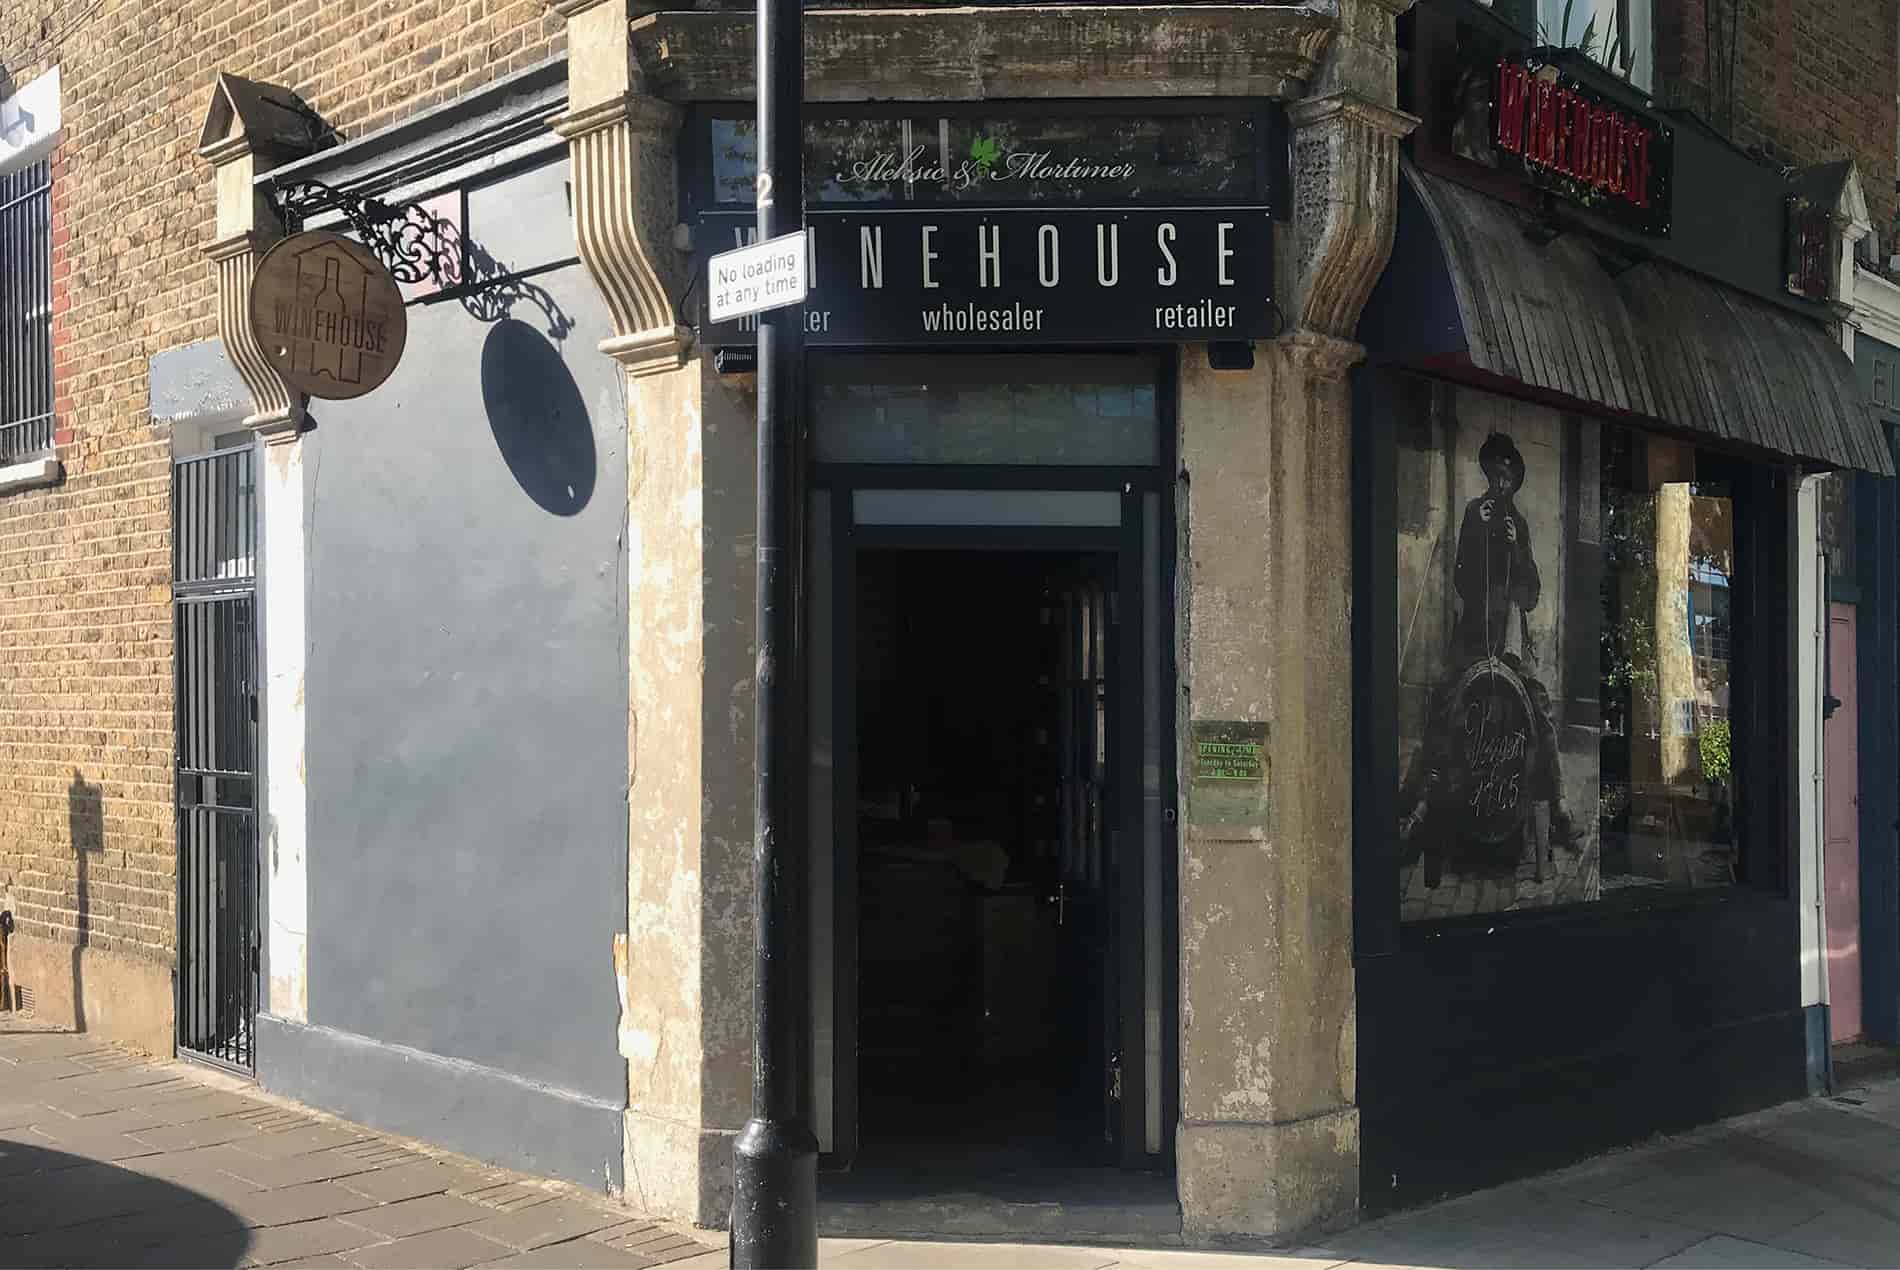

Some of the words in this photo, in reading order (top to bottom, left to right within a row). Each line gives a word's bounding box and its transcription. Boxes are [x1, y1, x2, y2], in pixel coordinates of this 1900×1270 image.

[953, 160, 979, 189] &
[990, 150, 1135, 182] Mortimer
[718, 266, 737, 286] No
[743, 254, 796, 279] loading
[716, 291, 729, 307] at
[735, 286, 760, 302] any
[766, 275, 798, 295] time
[273, 301, 386, 353] WINEHOUSE
[922, 302, 1044, 331] wholesaler
[1155, 298, 1236, 329] retailer
